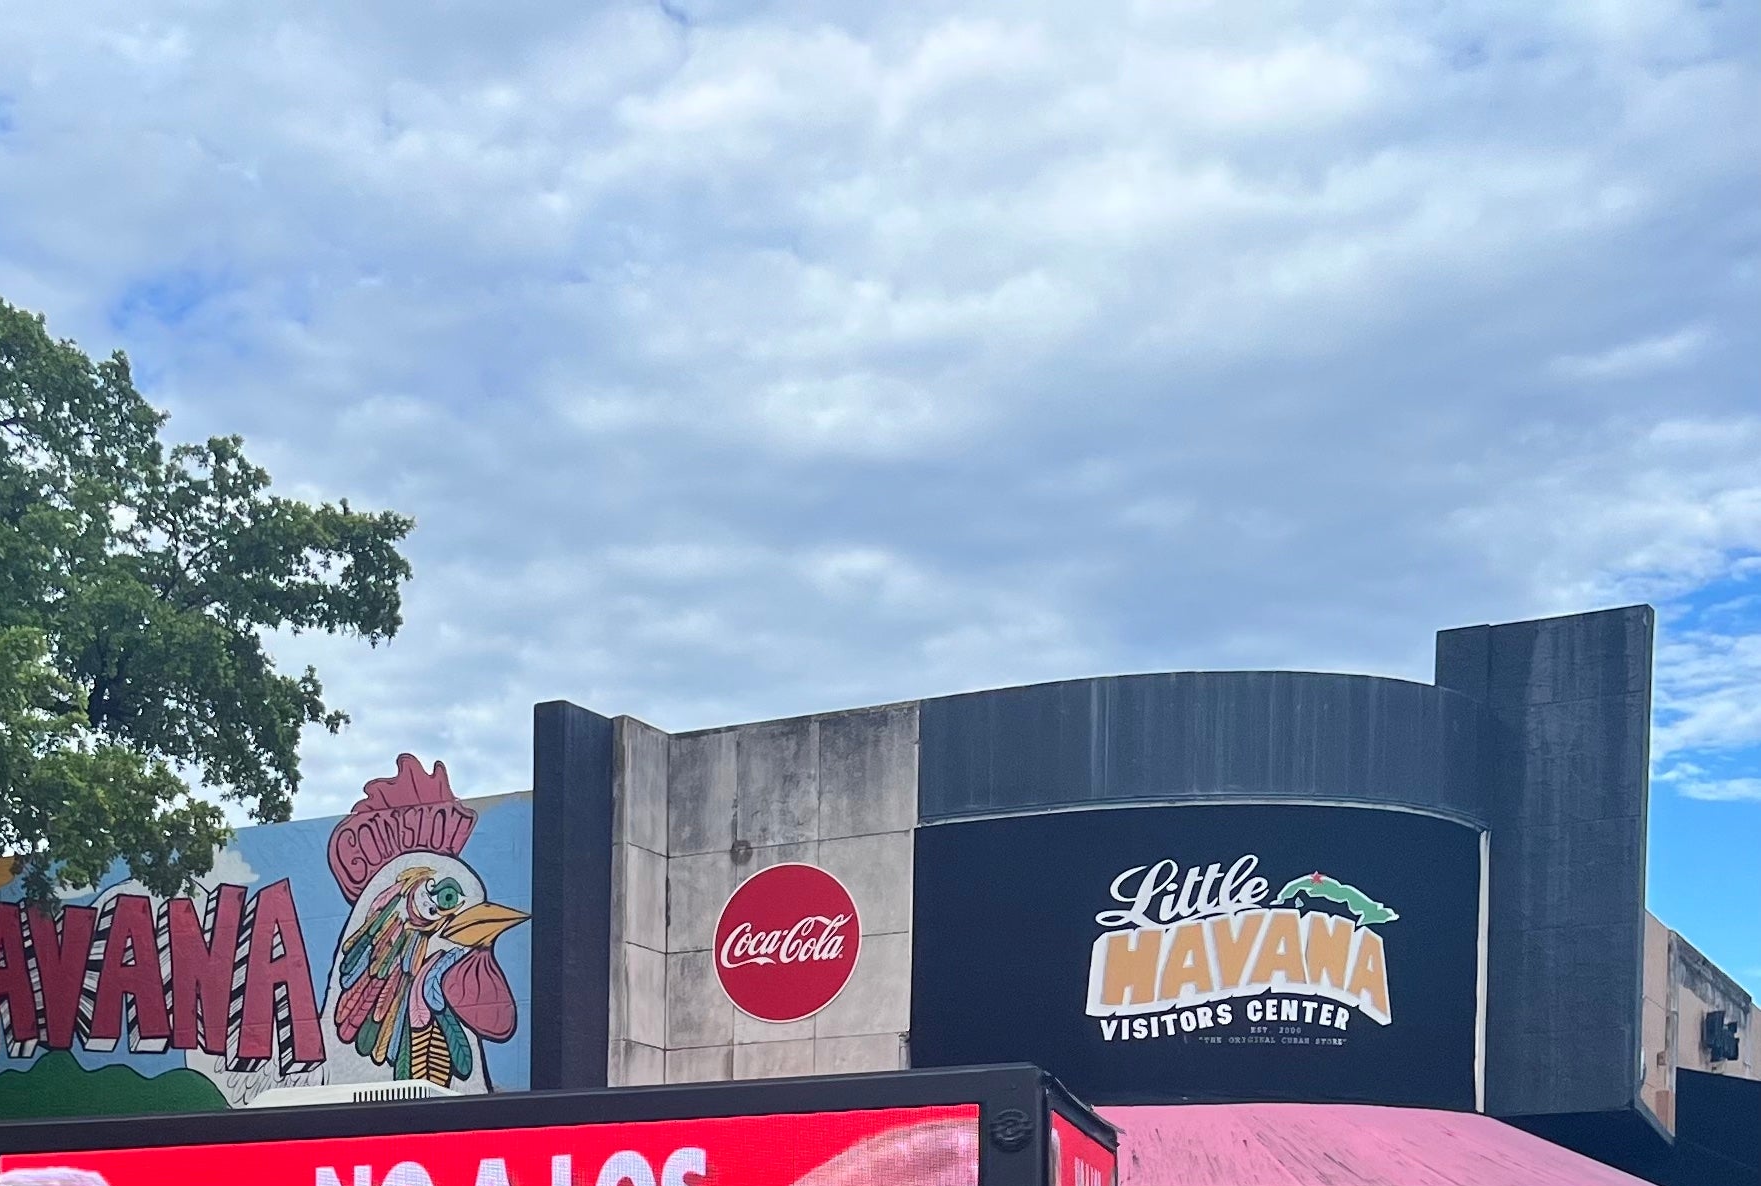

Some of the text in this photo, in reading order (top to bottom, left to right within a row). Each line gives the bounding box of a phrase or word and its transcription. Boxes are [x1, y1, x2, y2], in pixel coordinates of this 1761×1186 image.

[335, 806, 474, 885] COINSLOT
[1095, 854, 1269, 928] Little
[720, 912, 854, 969] Coca-Cola
[1085, 908, 1392, 1027] HAVANA
[1099, 999, 1351, 1041] VISITORS CENTER
